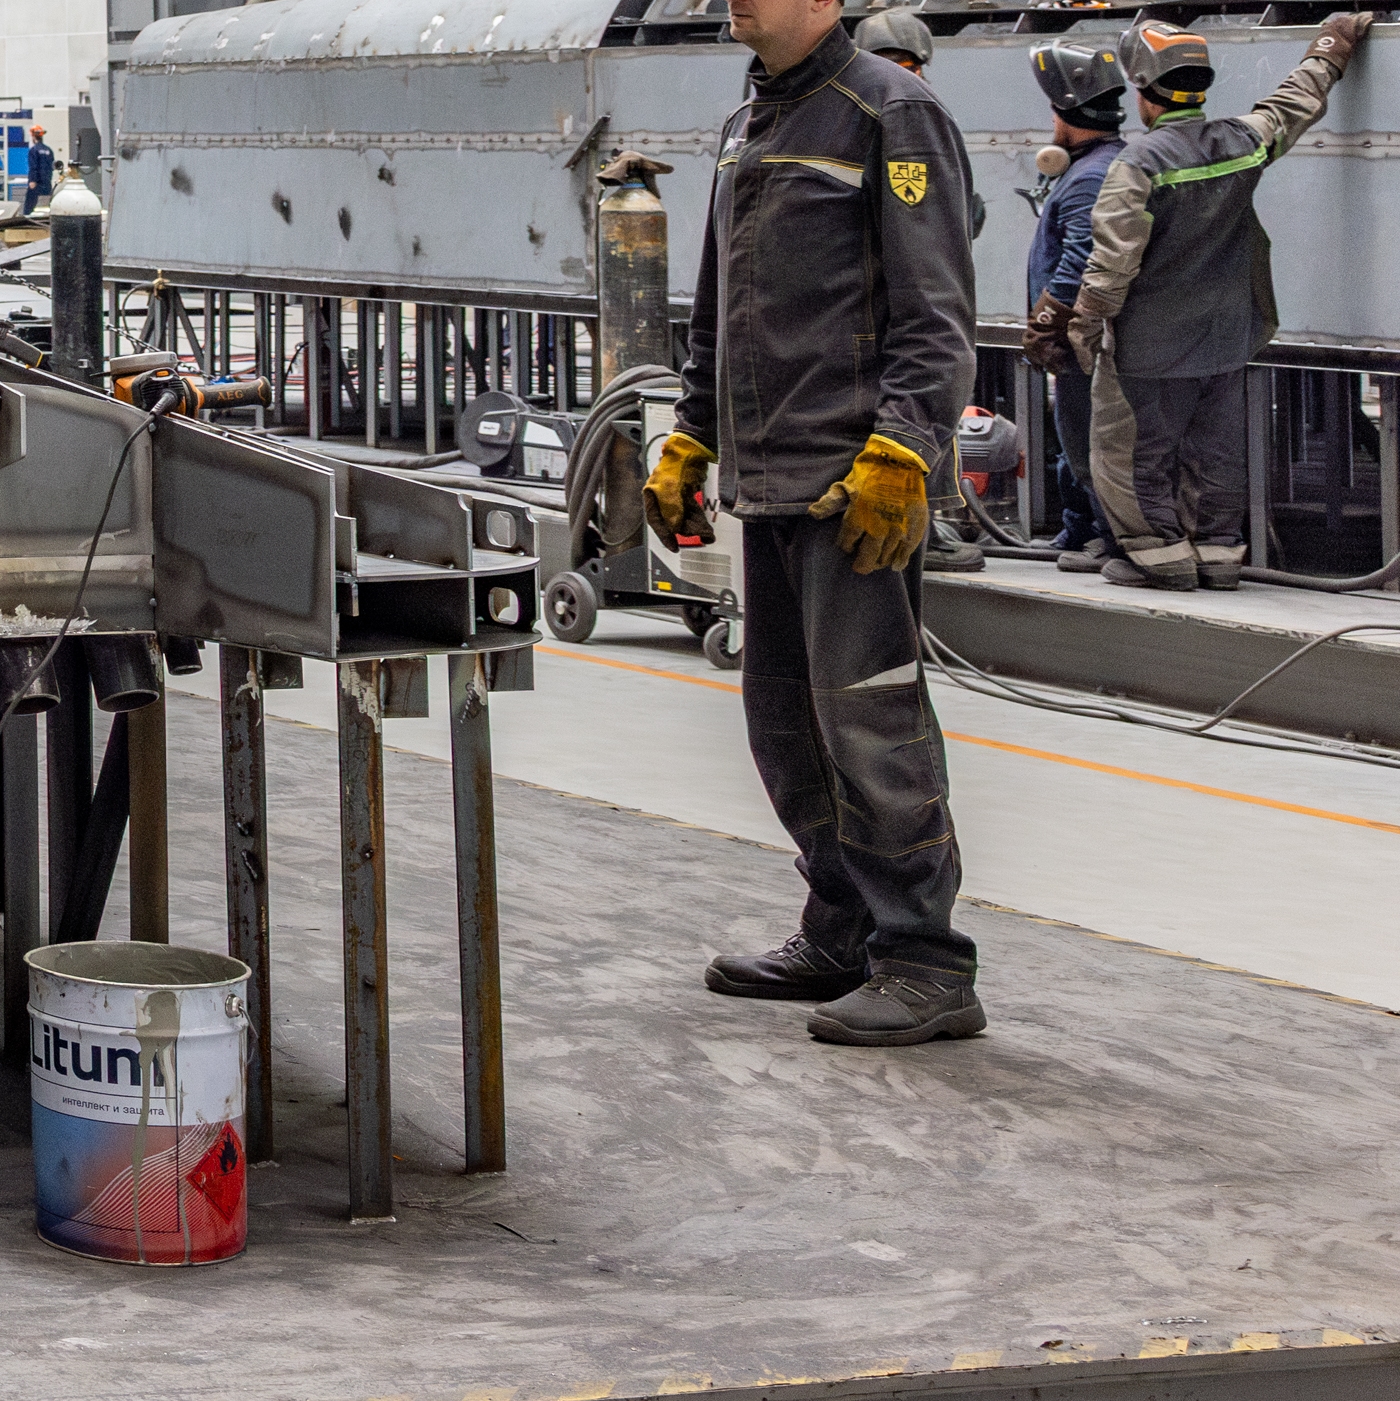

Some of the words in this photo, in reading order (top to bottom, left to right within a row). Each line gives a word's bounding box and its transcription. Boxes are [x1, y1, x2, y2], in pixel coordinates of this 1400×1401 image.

[217, 389, 244, 402] AEG
[31, 1017, 166, 1087] Litum
[62, 1096, 111, 1113] интеллект
[113, 1105, 120, 1113] и
